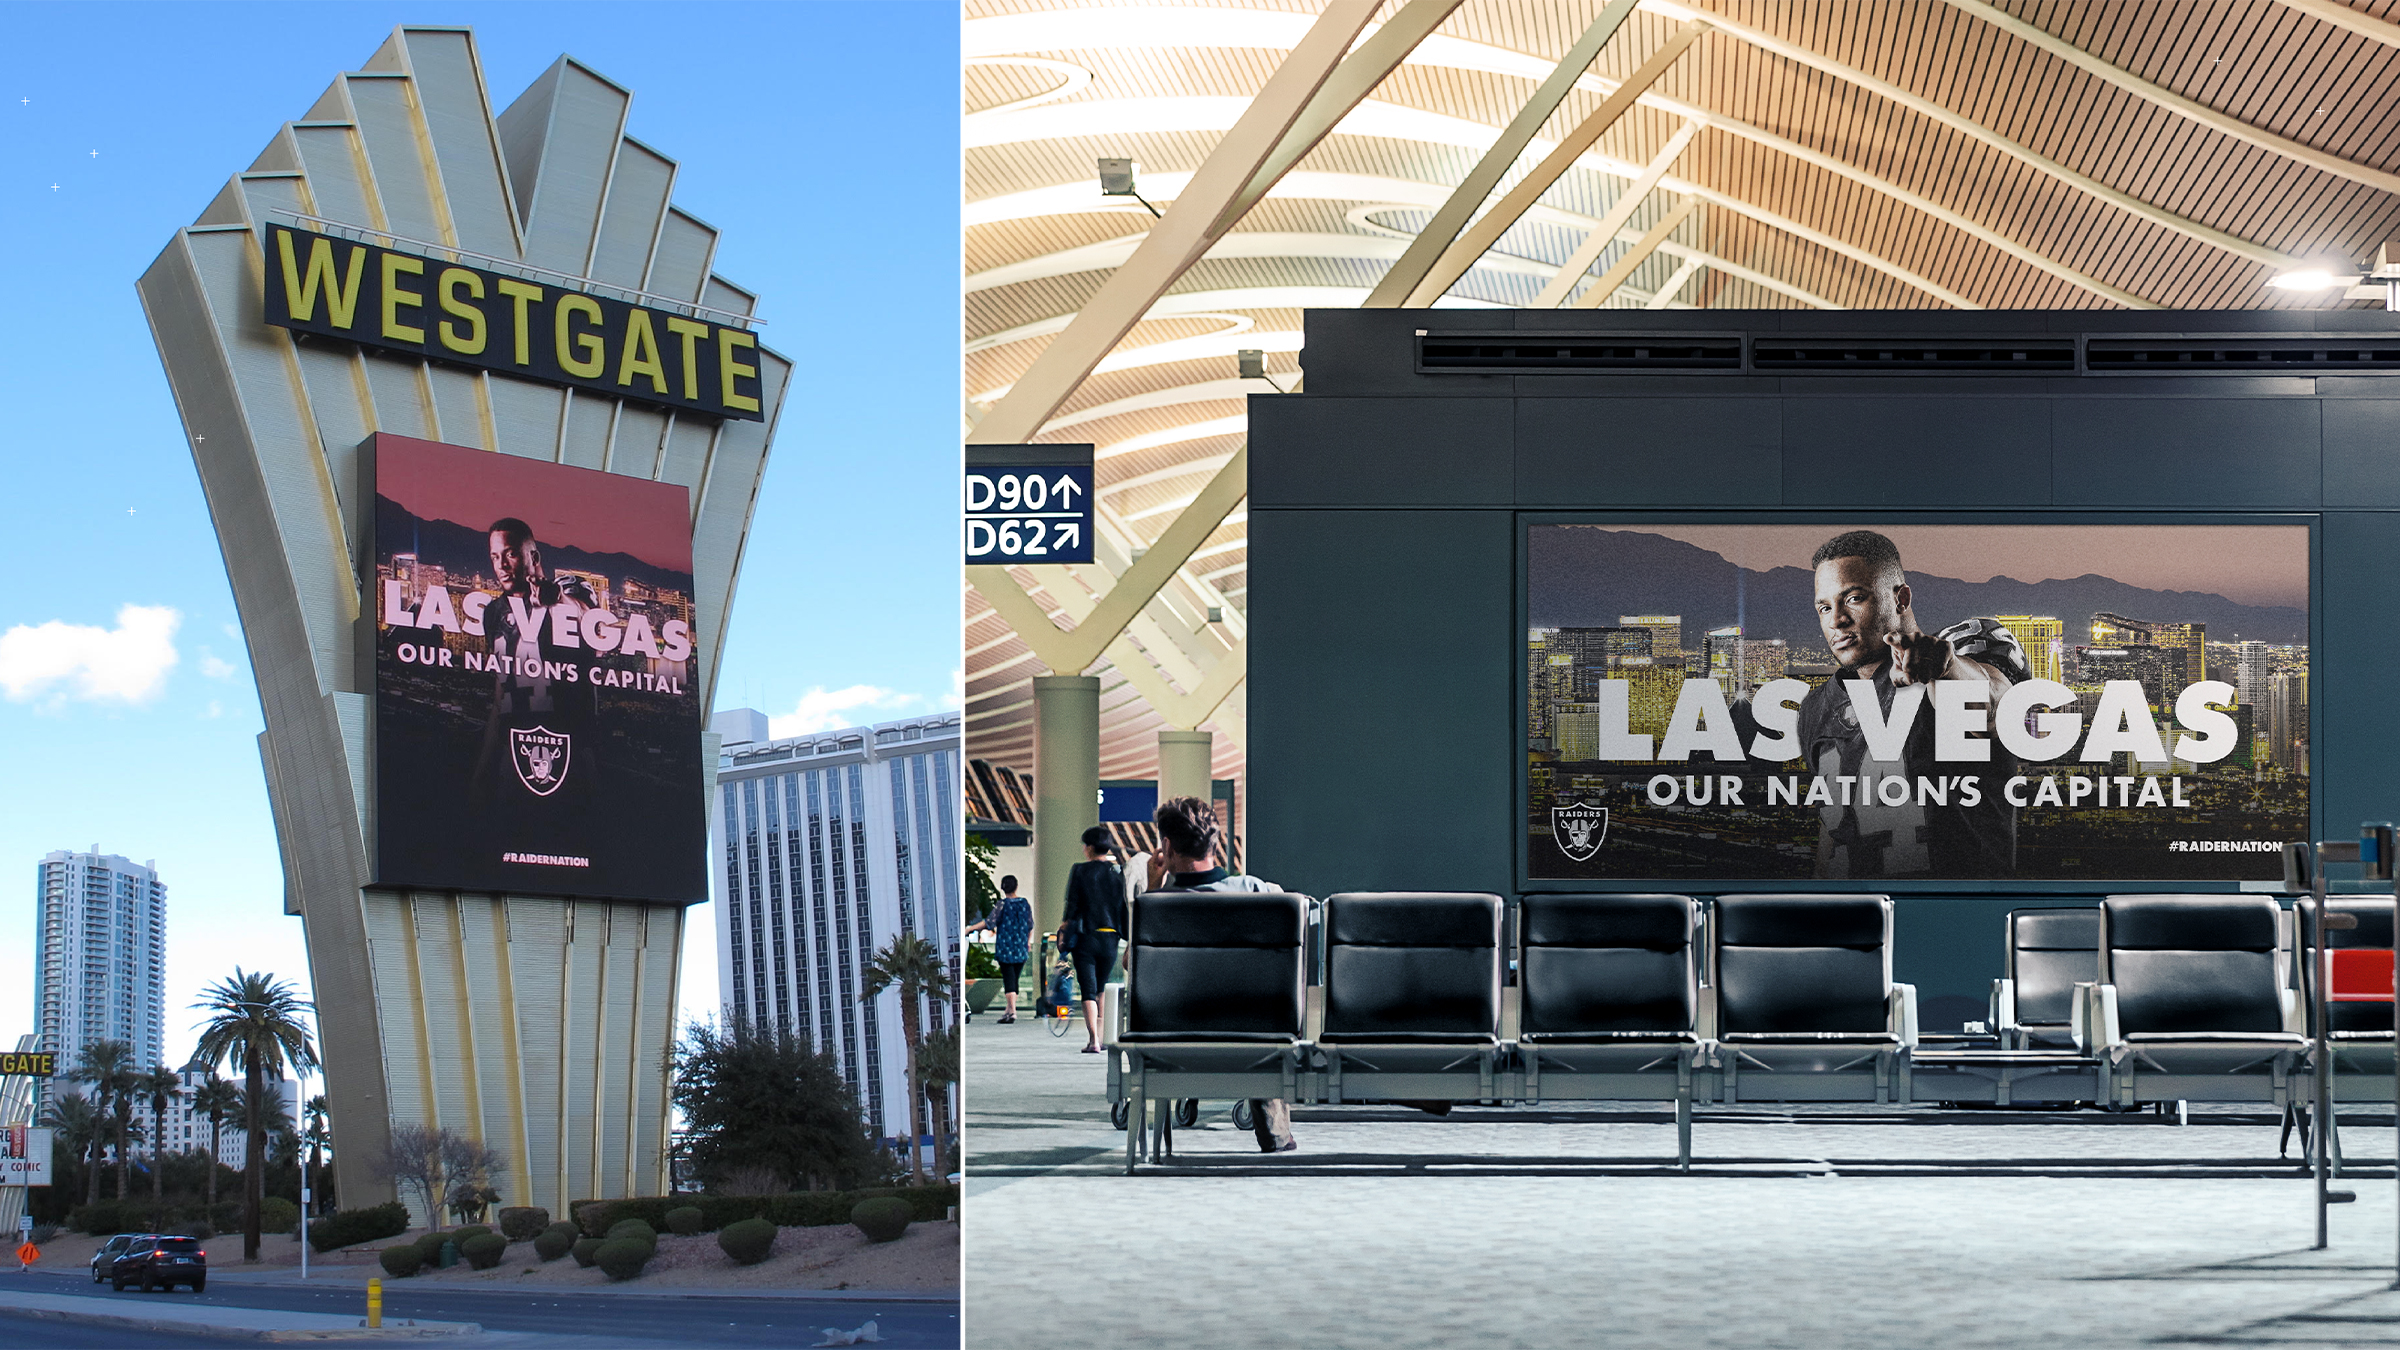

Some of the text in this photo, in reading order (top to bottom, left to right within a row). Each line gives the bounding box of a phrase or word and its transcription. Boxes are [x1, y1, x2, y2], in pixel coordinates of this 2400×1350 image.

[276, 229, 760, 413] WESTGATE
[966, 474, 1047, 511] D90
[967, 519, 1047, 556] D62
[384, 580, 691, 662] LAS VEGAS
[398, 643, 682, 695] OUR NATION'S CAPITAL
[1600, 678, 2239, 763] LAS VEGAS
[518, 734, 563, 746] RAIDERS
[1647, 774, 2190, 807] OUR NATION'S CAPITAL
[502, 852, 589, 867] #RAIDERNATION
[2169, 841, 2283, 853] #RAIDERNATION
[0, 1054, 52, 1073] GATE
[11, 1162, 41, 1171] COMIC
